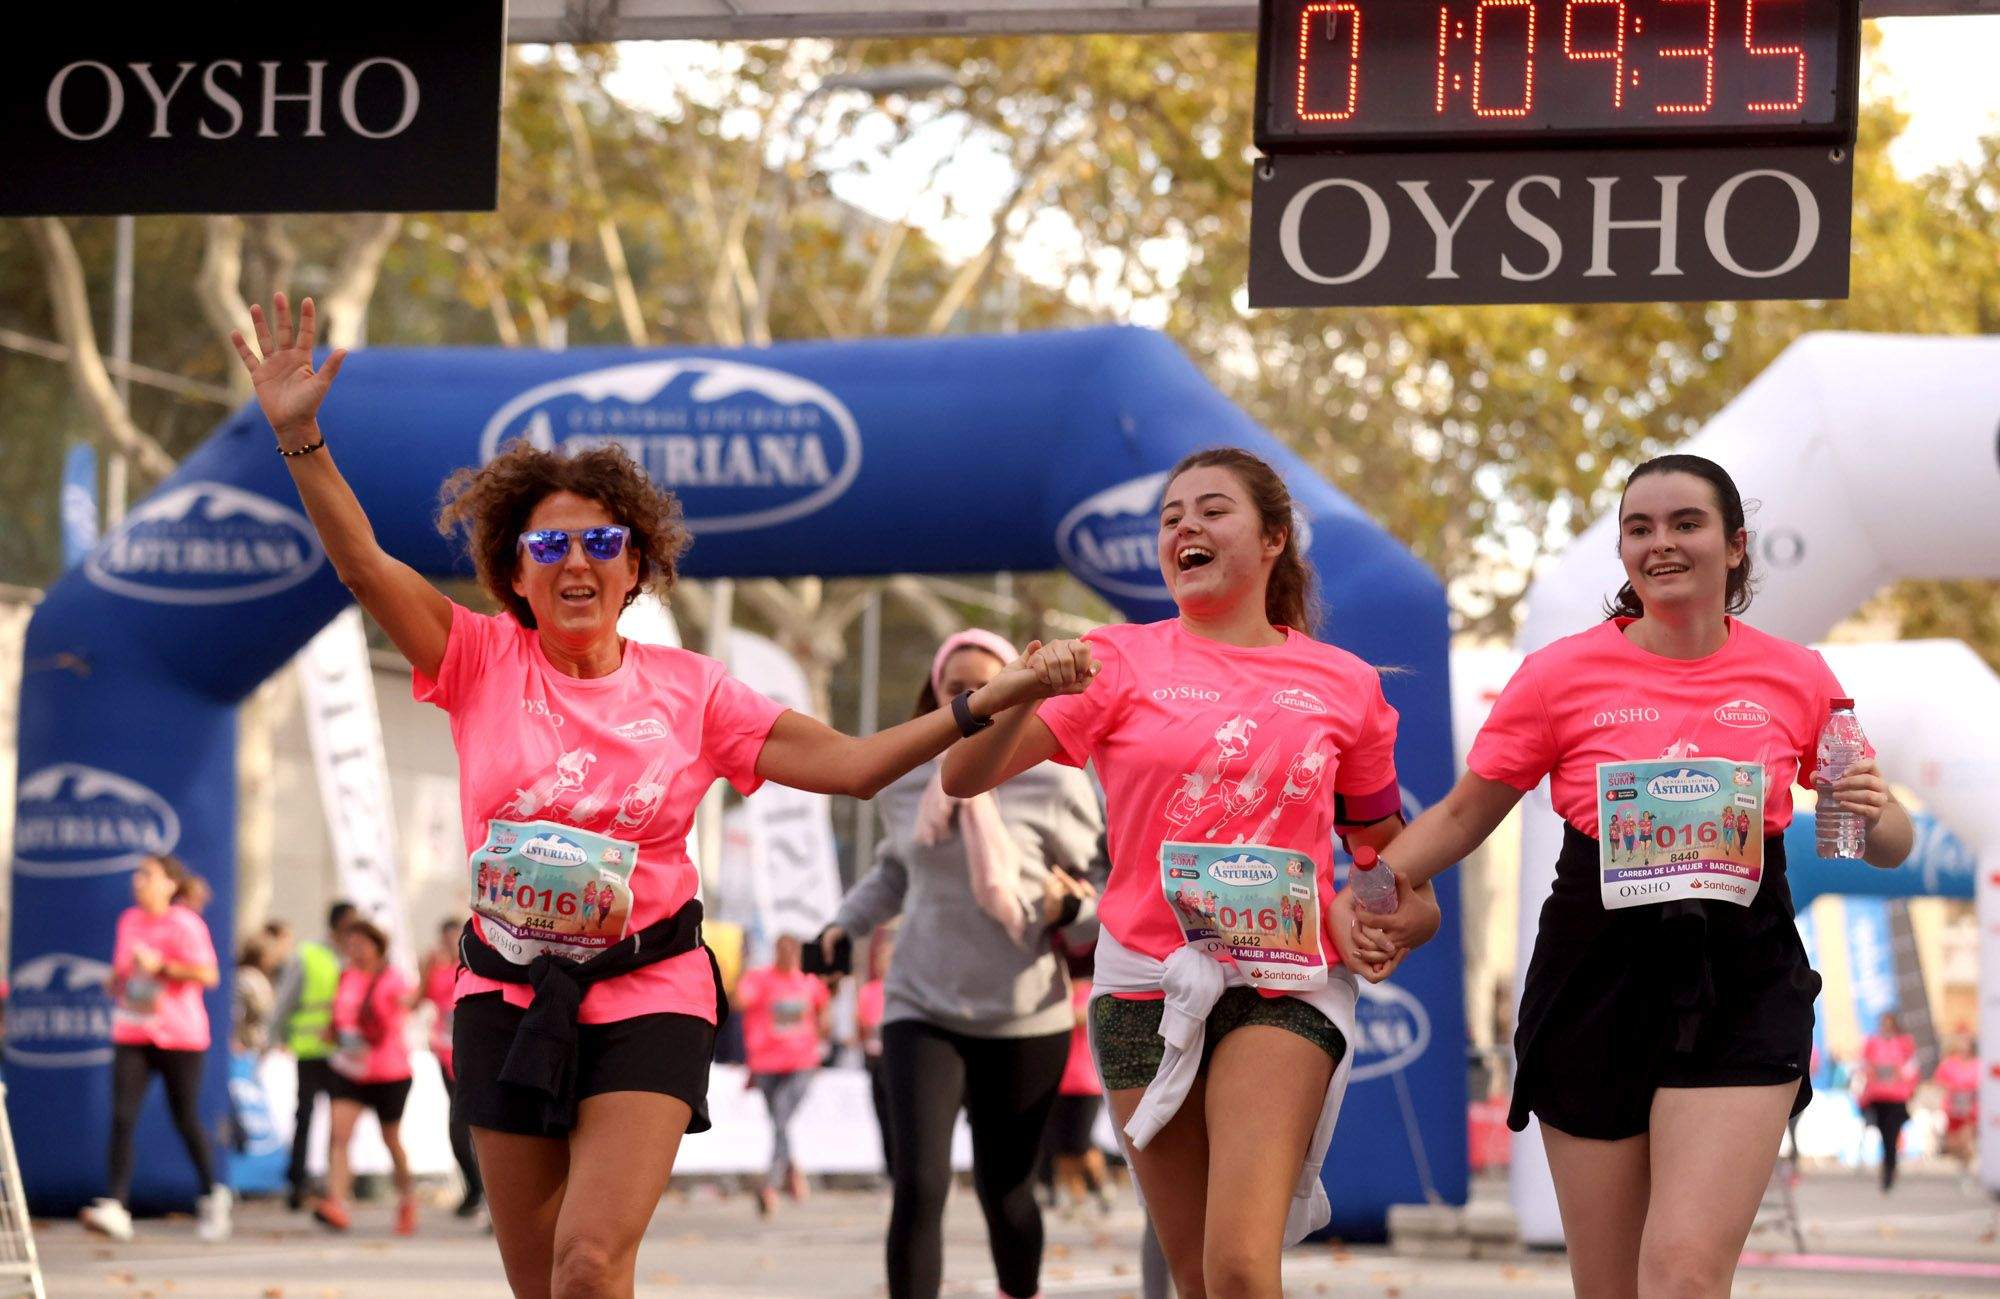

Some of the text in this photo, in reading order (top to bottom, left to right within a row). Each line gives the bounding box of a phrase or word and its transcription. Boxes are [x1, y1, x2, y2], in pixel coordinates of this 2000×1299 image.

[46, 57, 420, 141] OYSHO
[1279, 169, 1820, 285] OYSHO
[1153, 687, 1221, 703] OYSHO
[1594, 708, 1660, 727] OYSHO
[1720, 709, 1767, 723] ASTURIANA
[1652, 781, 1716, 795] ASTURIANA
[1655, 821, 1718, 848] 016
[1670, 850, 1699, 863] 8440
[1213, 866, 1273, 879] ASTURIANA
[1618, 868, 1653, 878] CARRERA
[1654, 867, 1664, 875] DE
[1677, 863, 1703, 872] MUJER
[1709, 862, 1750, 876] BARCELONA
[1620, 880, 1747, 898] OYSHO Santander
[516, 885, 577, 915] 016
[526, 916, 554, 929] 8444
[1220, 906, 1278, 930] 016
[1232, 935, 1260, 946] 8442
[1239, 949, 1264, 959] MUJER
[1270, 951, 1309, 963] BARCELONA
